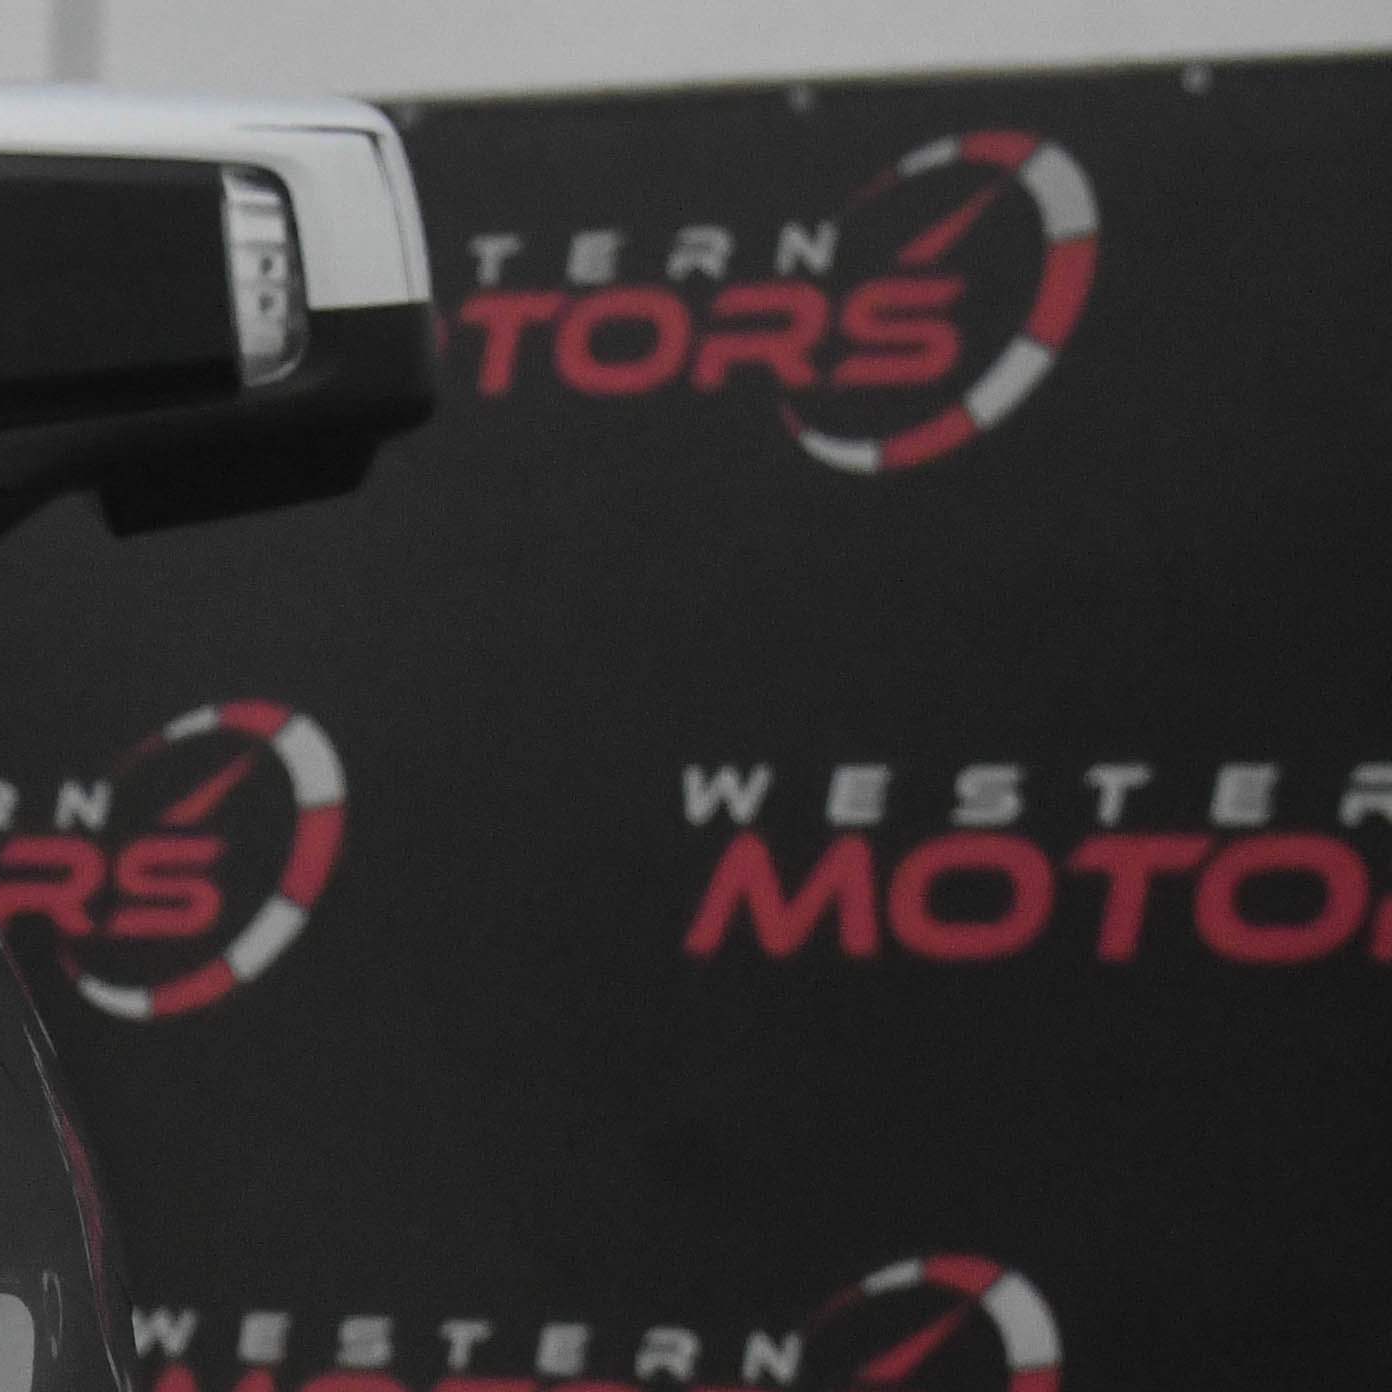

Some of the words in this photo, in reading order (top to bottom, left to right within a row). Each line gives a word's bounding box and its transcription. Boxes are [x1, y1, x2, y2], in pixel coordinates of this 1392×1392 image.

[434, 275, 964, 396] TORS
[683, 830, 1392, 963] MOTO
[130, 1304, 802, 1384] WESTERN
